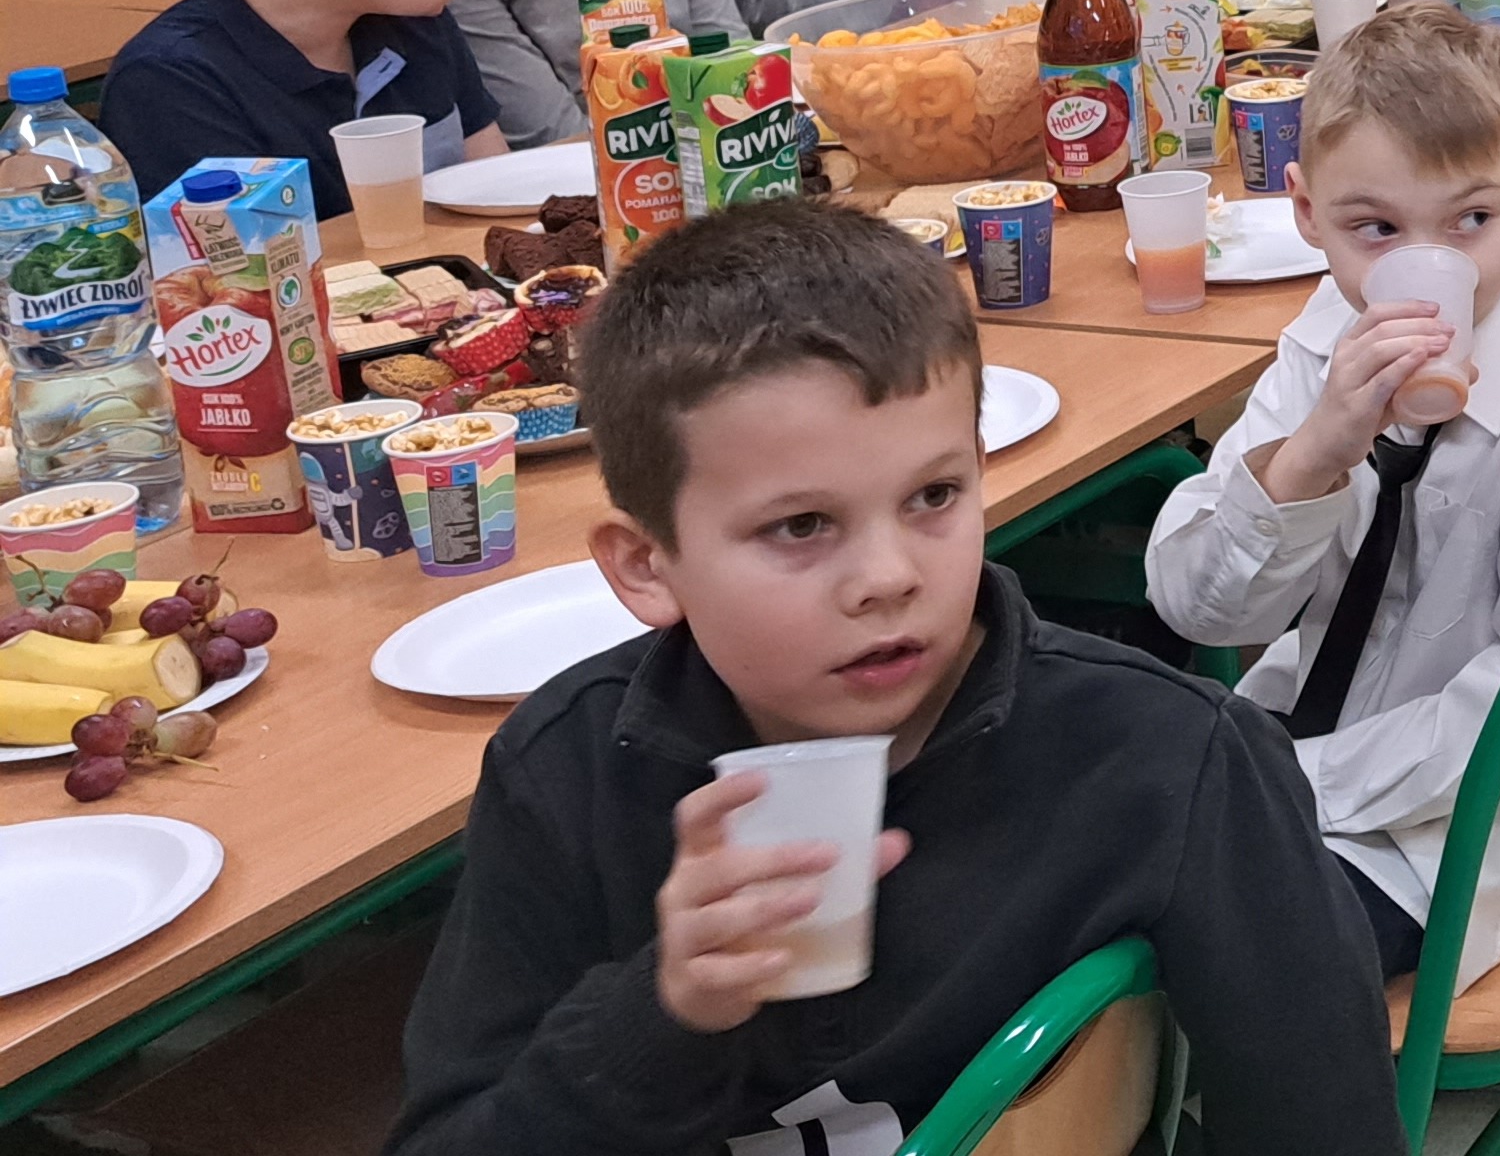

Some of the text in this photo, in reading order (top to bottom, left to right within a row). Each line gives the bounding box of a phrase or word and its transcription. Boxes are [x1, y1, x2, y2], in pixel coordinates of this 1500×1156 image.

[1050, 105, 1100, 135] Hortex
[608, 116, 675, 155] RIVI
[635, 169, 681, 194] SO
[625, 193, 683, 210] POMARA
[19, 285, 88, 320] ŻYWIEC
[170, 324, 262, 377] Hortex
[200, 408, 252, 427] JABŁKO
